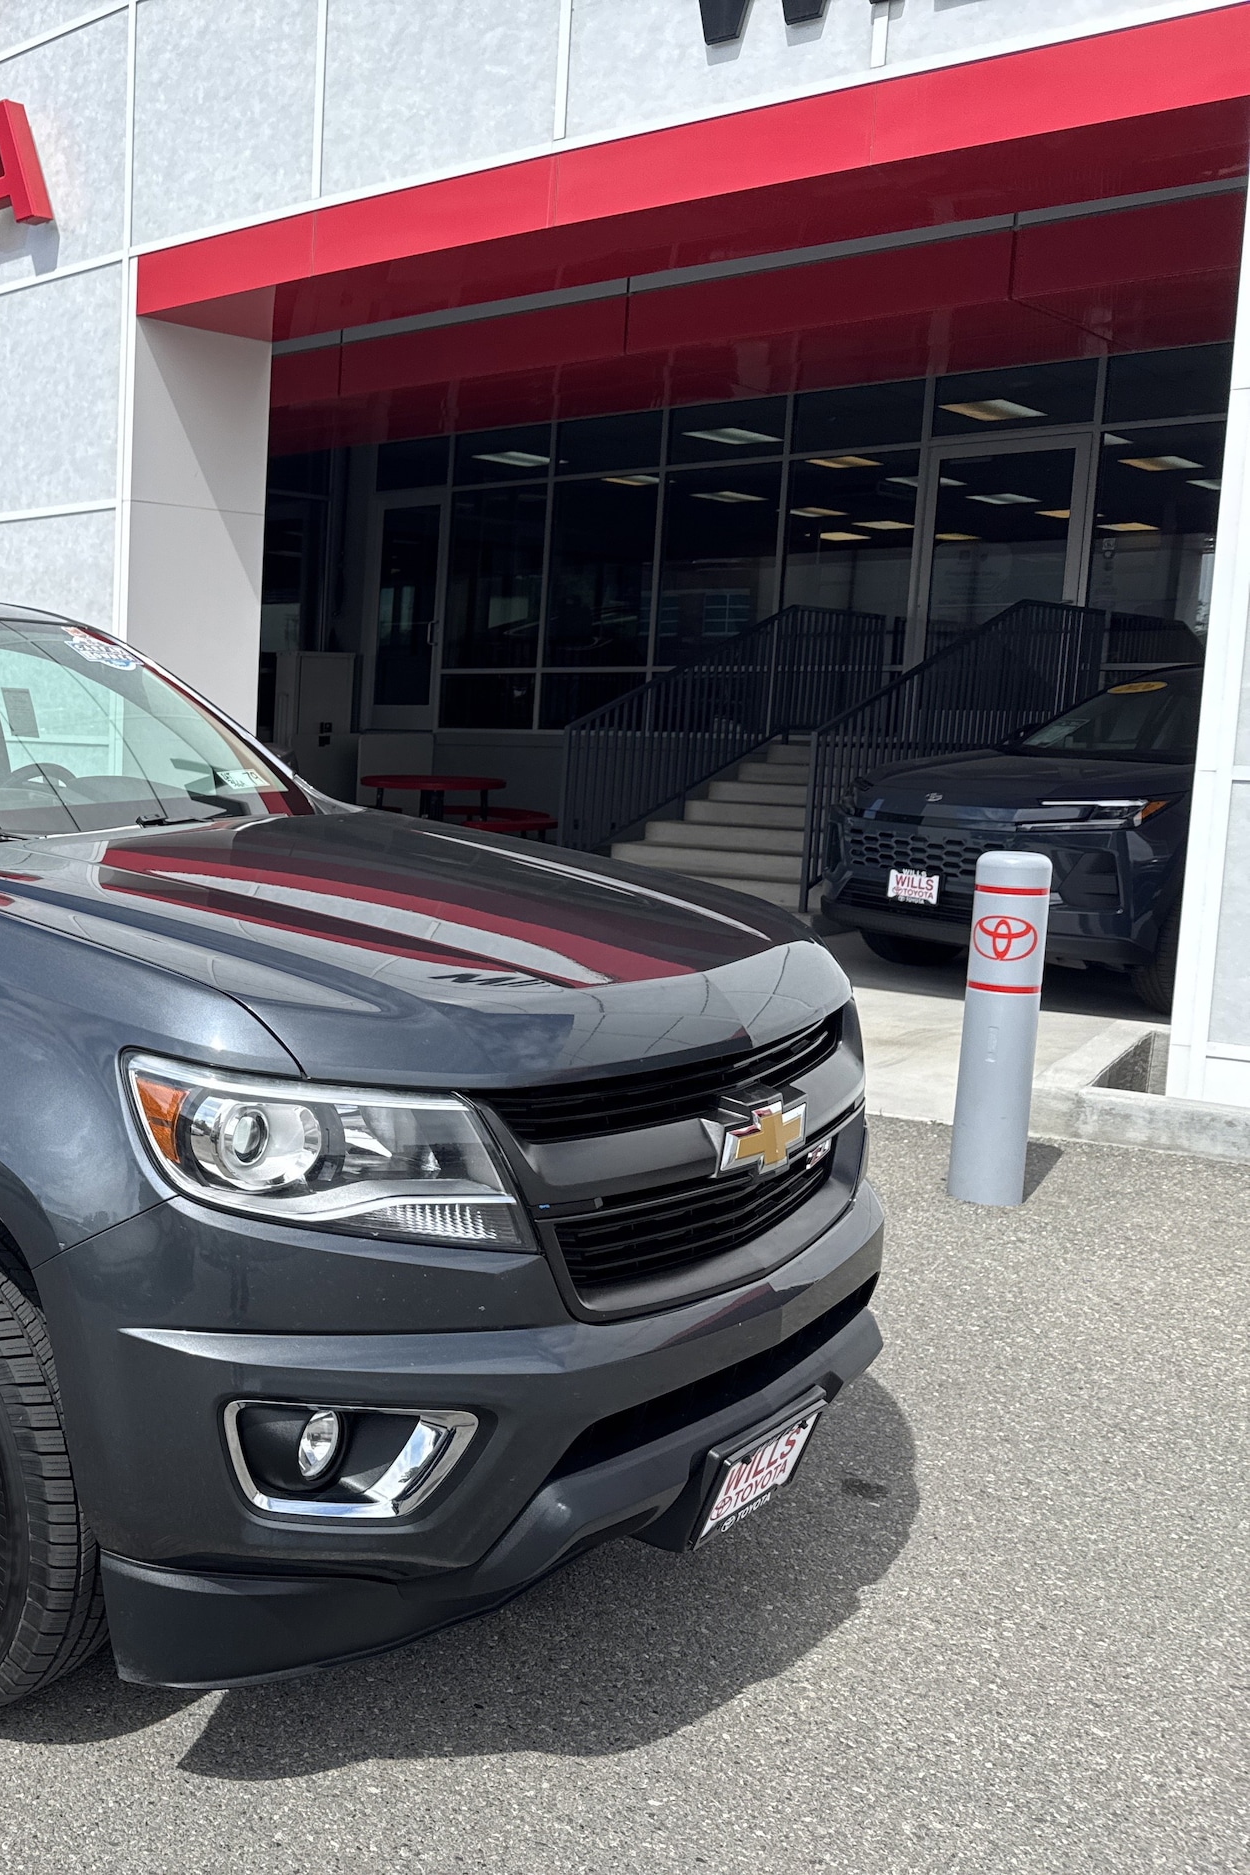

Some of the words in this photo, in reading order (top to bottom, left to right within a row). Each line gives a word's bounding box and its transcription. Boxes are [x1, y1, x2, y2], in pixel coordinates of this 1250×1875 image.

[895, 875, 934, 891] WILLS
[903, 888, 934, 899] TOYOTA
[724, 1427, 801, 1496] WILLS
[733, 1459, 787, 1508] TOYOTA
[736, 1492, 771, 1522] TOYOTA
